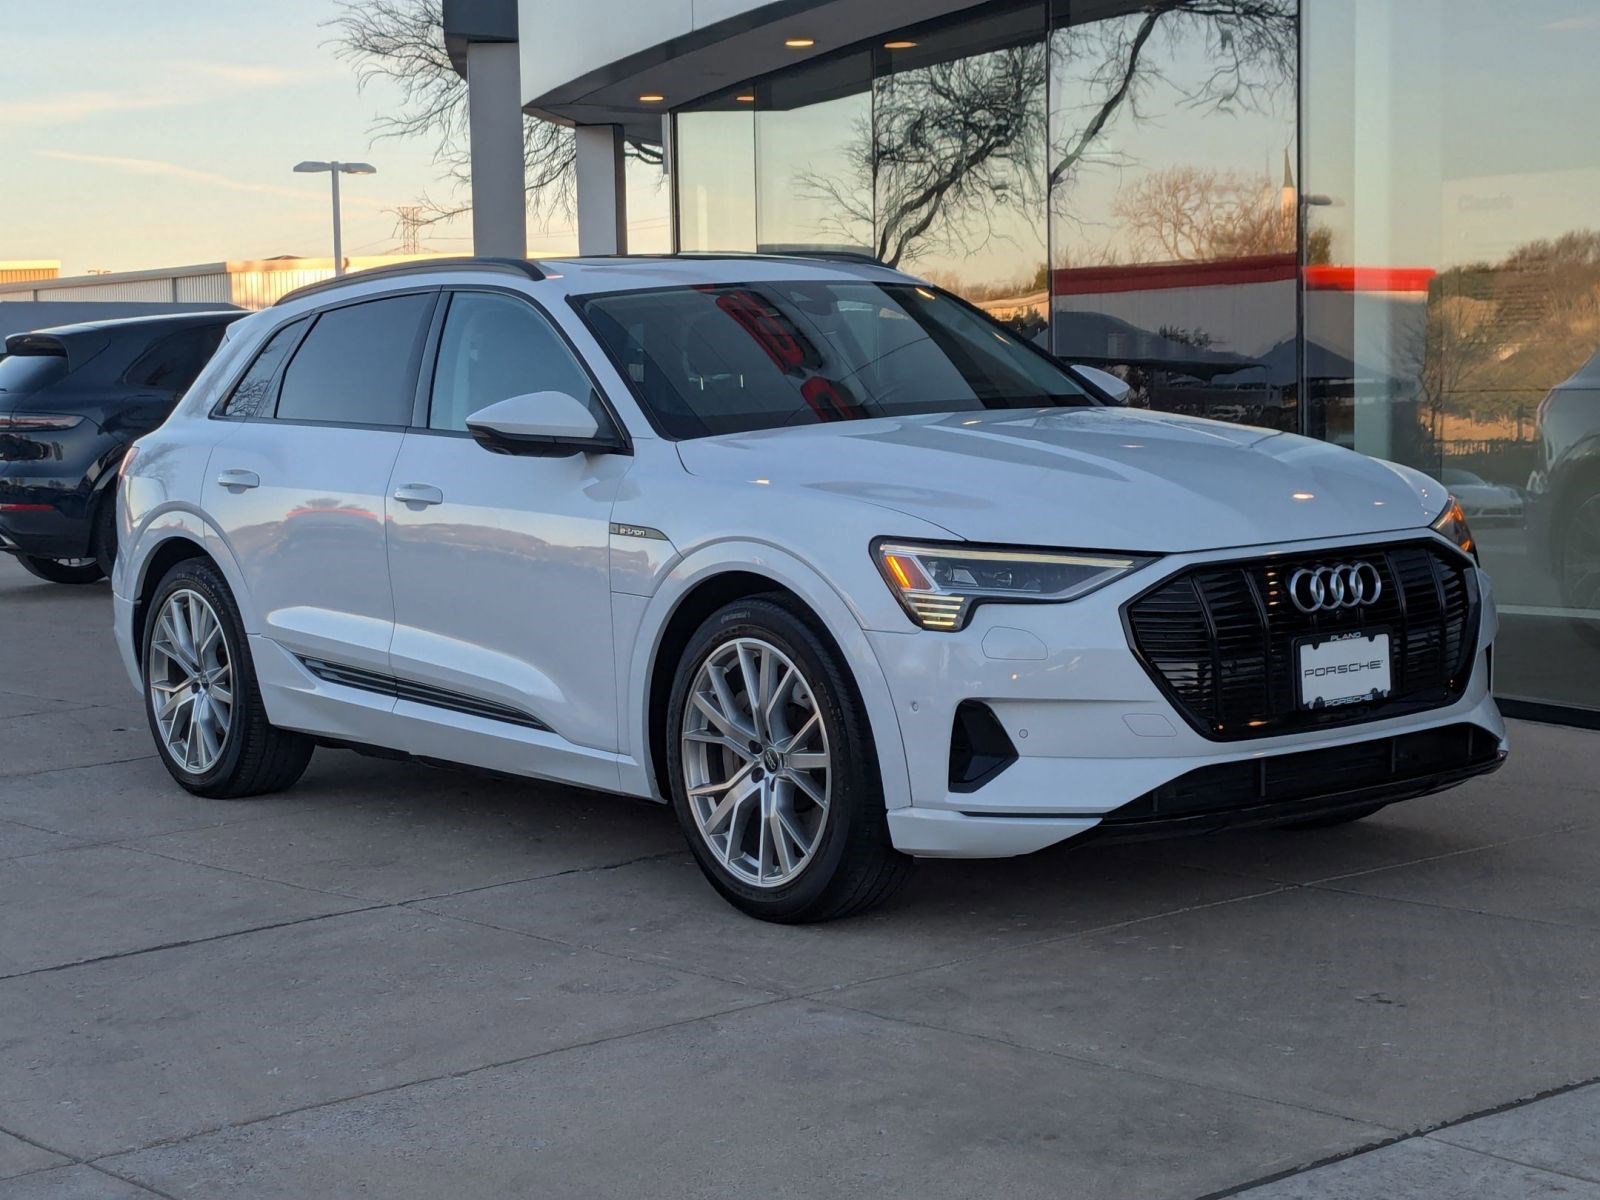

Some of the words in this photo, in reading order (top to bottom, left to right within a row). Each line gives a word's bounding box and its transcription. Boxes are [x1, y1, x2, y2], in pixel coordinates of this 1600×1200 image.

[620, 528, 644, 536] e-tron
[1330, 632, 1361, 640] PLANO
[1304, 660, 1382, 678] PORSCHE
